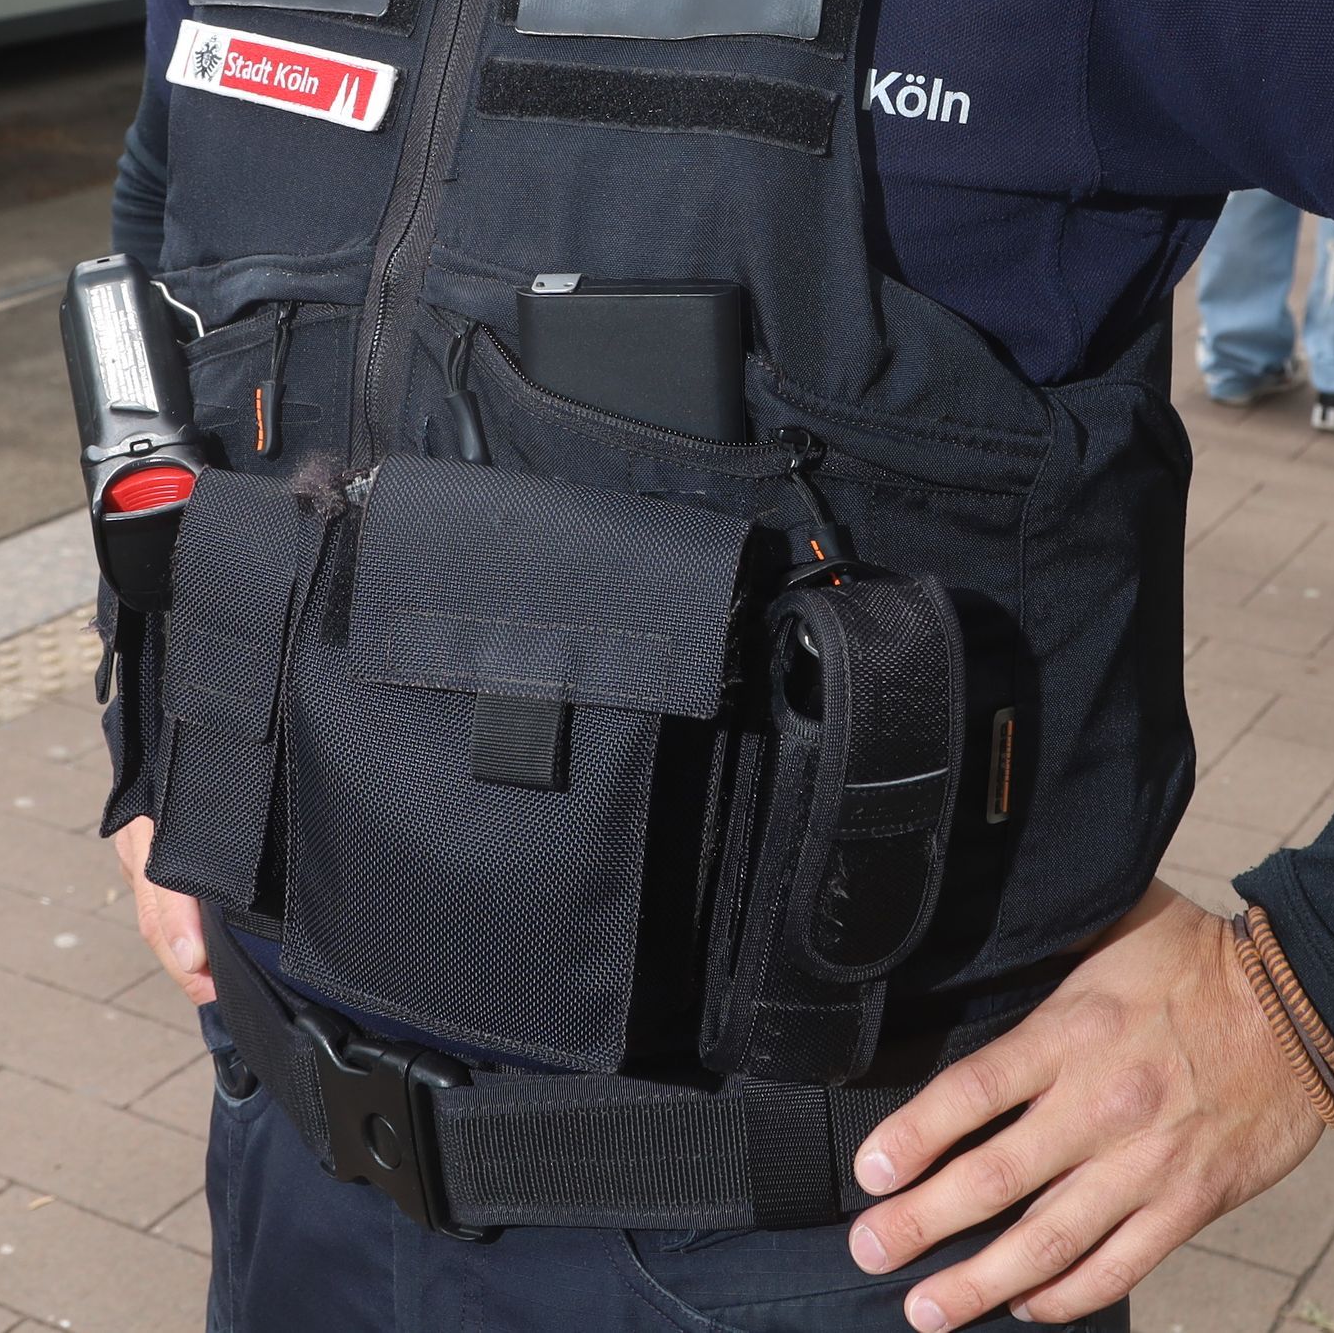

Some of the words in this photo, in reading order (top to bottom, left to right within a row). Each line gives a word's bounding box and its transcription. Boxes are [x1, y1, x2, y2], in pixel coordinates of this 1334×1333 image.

[224, 52, 273, 85] Stadt
[273, 64, 321, 95] Köln
[861, 68, 971, 124] Köln
